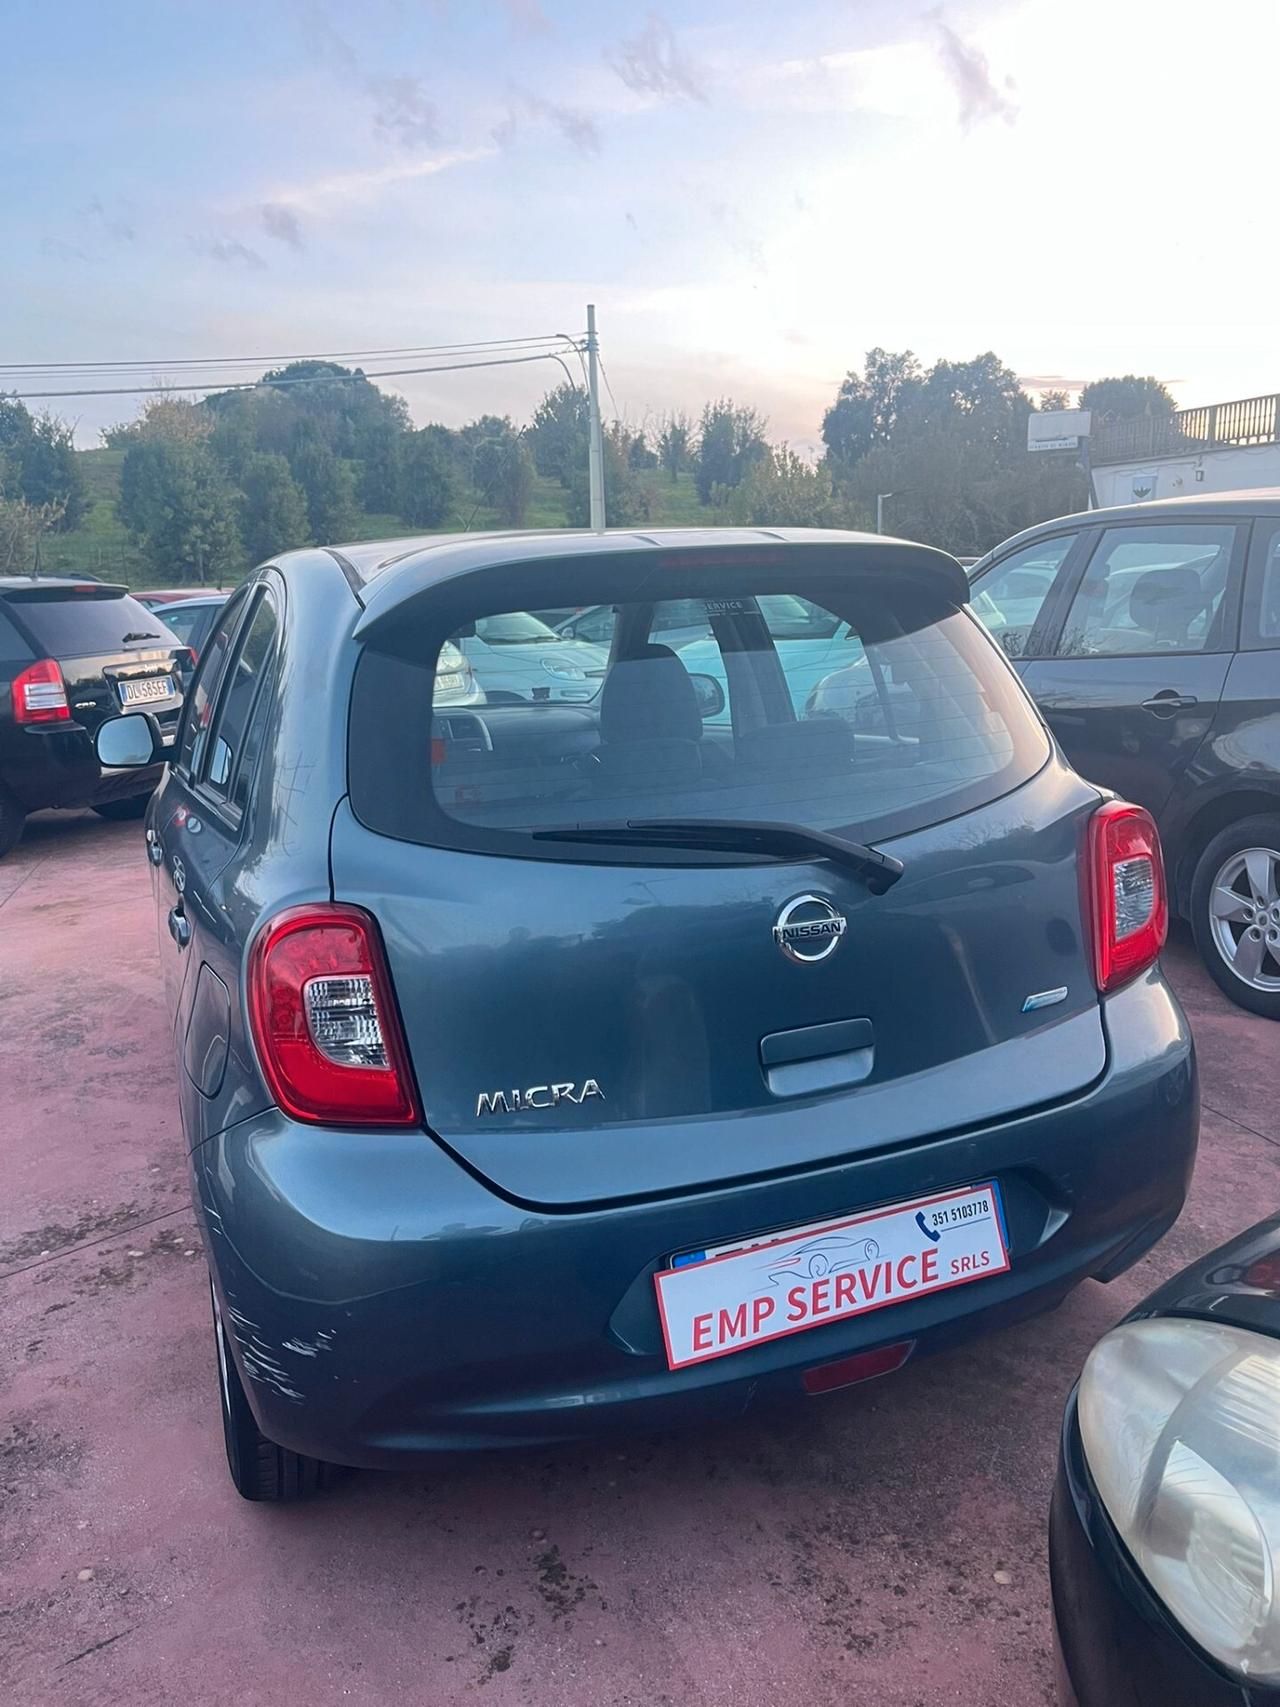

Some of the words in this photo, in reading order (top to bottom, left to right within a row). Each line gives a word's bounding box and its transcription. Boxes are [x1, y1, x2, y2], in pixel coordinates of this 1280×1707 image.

[782, 922, 841, 939] NISSAN
[476, 1078, 606, 1117] MICRA
[931, 1210, 949, 1226] 351
[950, 1199, 989, 1221] 5103778
[692, 1294, 776, 1353] EMP
[786, 1247, 940, 1323] SERVICE
[950, 1250, 991, 1275] SRLS
